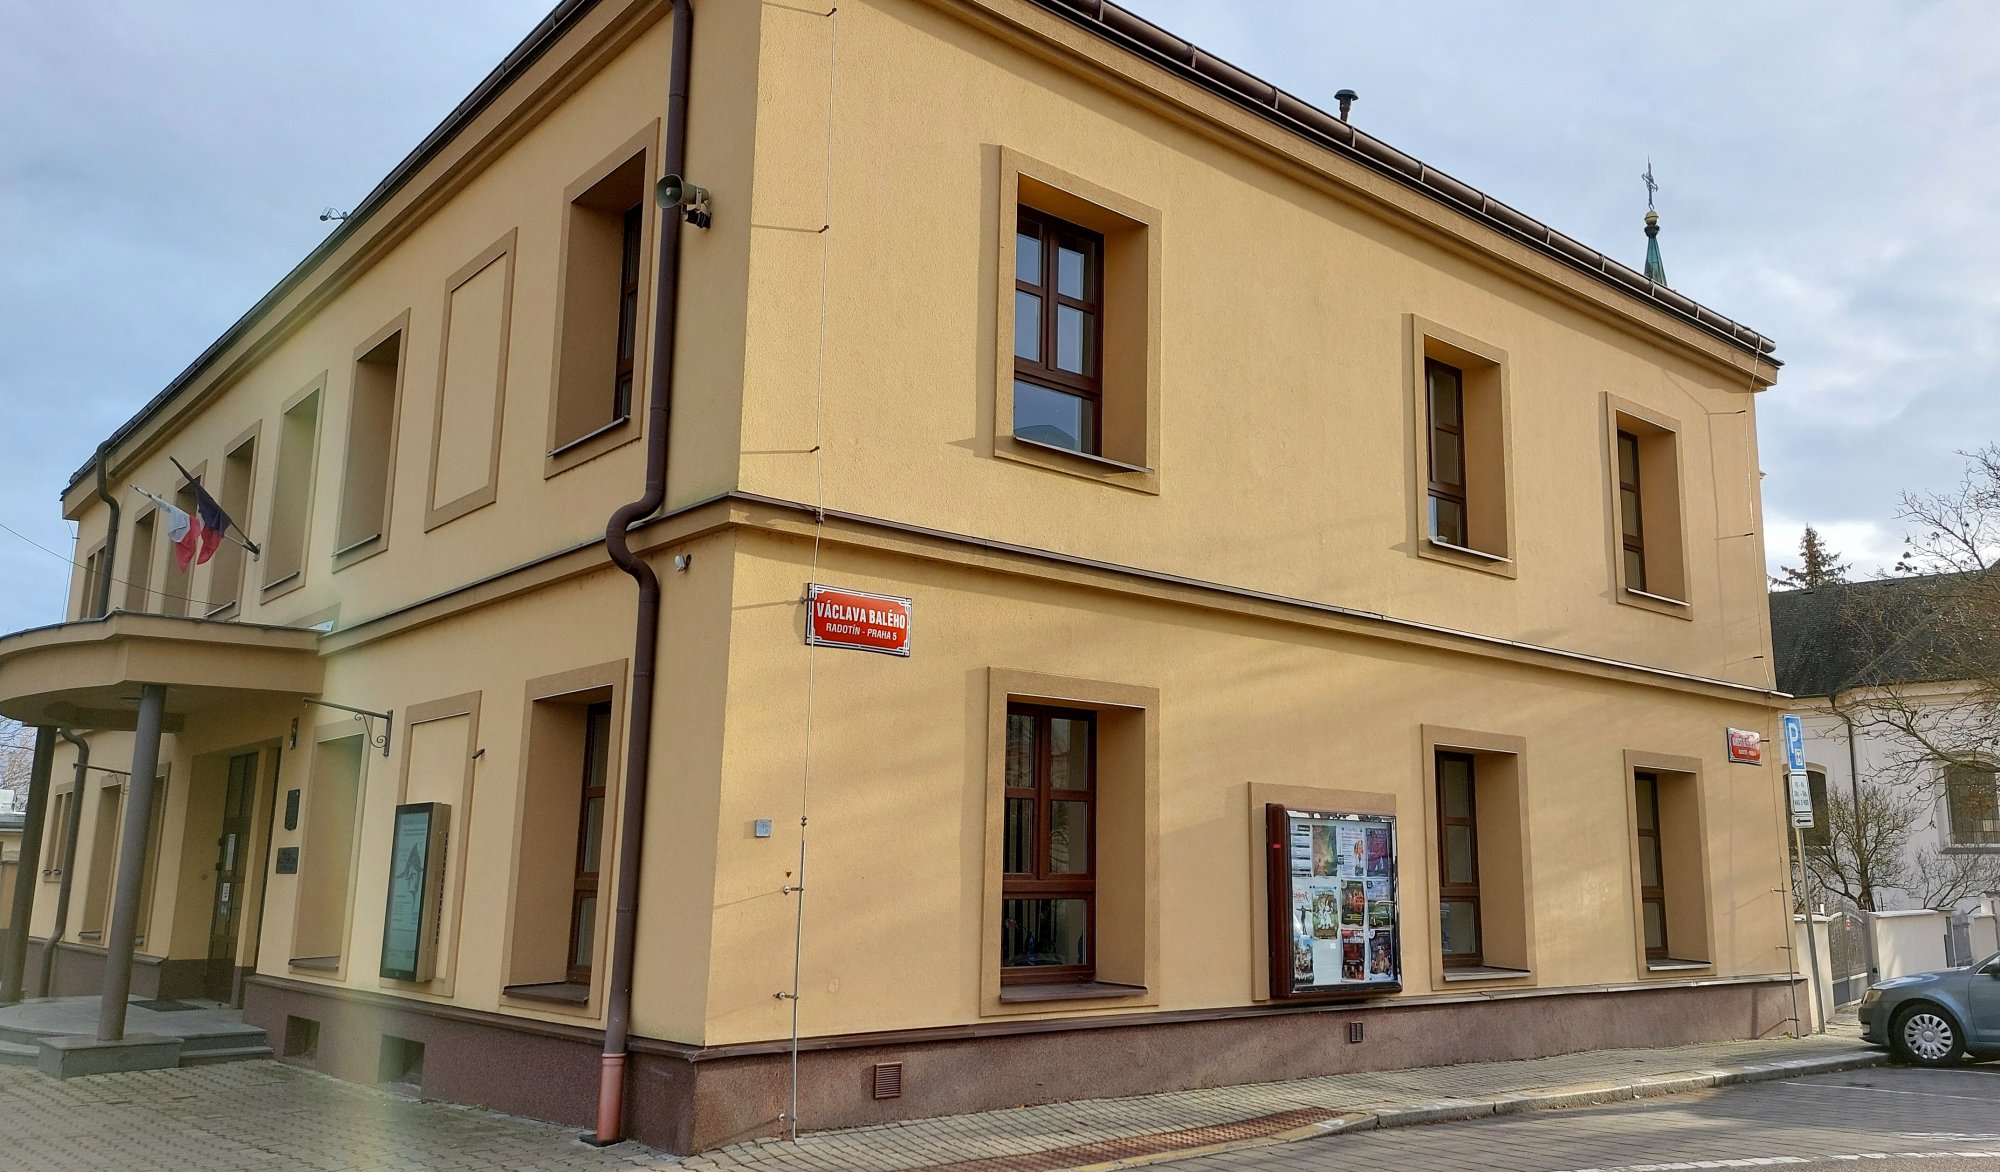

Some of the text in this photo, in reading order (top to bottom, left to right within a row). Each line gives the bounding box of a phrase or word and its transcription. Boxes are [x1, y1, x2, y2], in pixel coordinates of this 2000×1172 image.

[817, 600, 906, 630] VÁCLAVA BALÉHO
[826, 622, 861, 636] RADOTÍN
[867, 628, 891, 641] PRAHA
